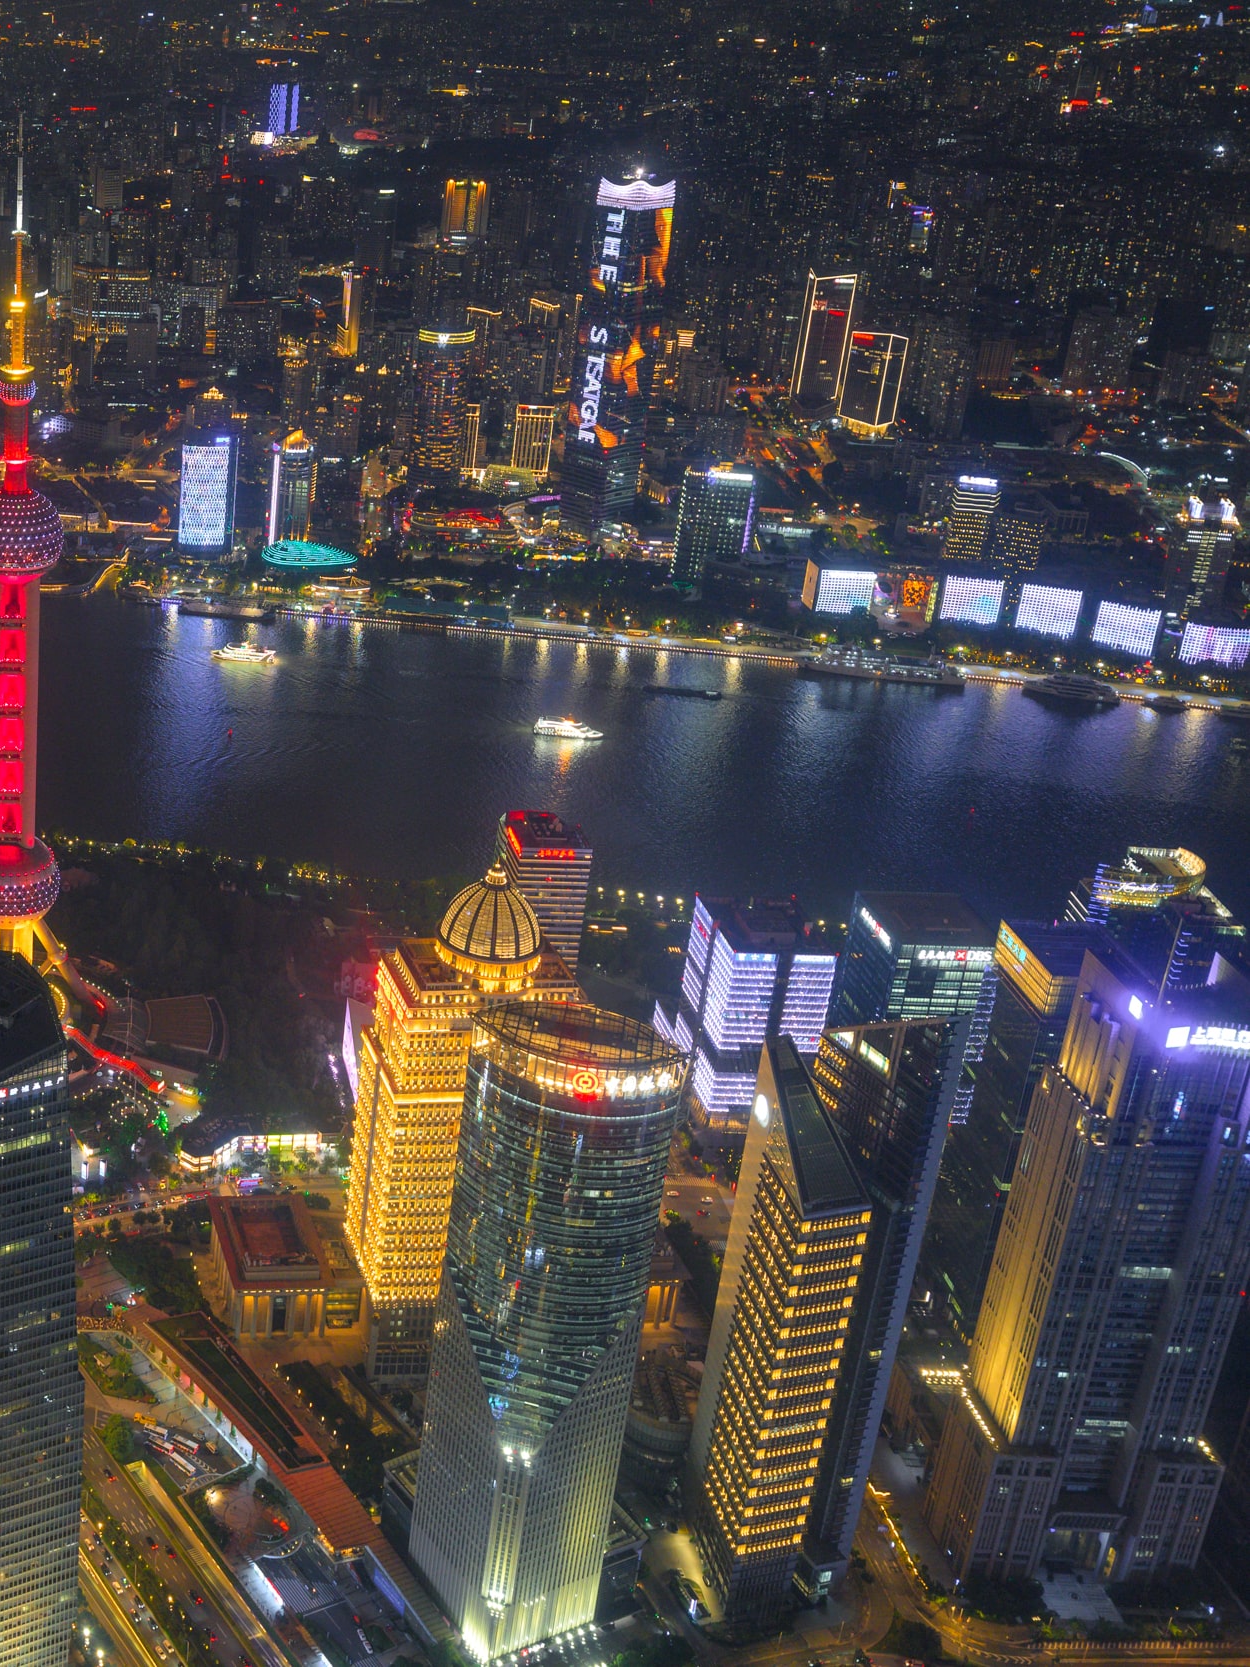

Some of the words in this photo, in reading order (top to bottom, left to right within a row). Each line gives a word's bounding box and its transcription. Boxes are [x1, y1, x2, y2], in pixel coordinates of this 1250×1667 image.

[438, 333, 450, 344] W
[966, 950, 992, 961] DBS
[605, 1071, 672, 1093] 中国银行
